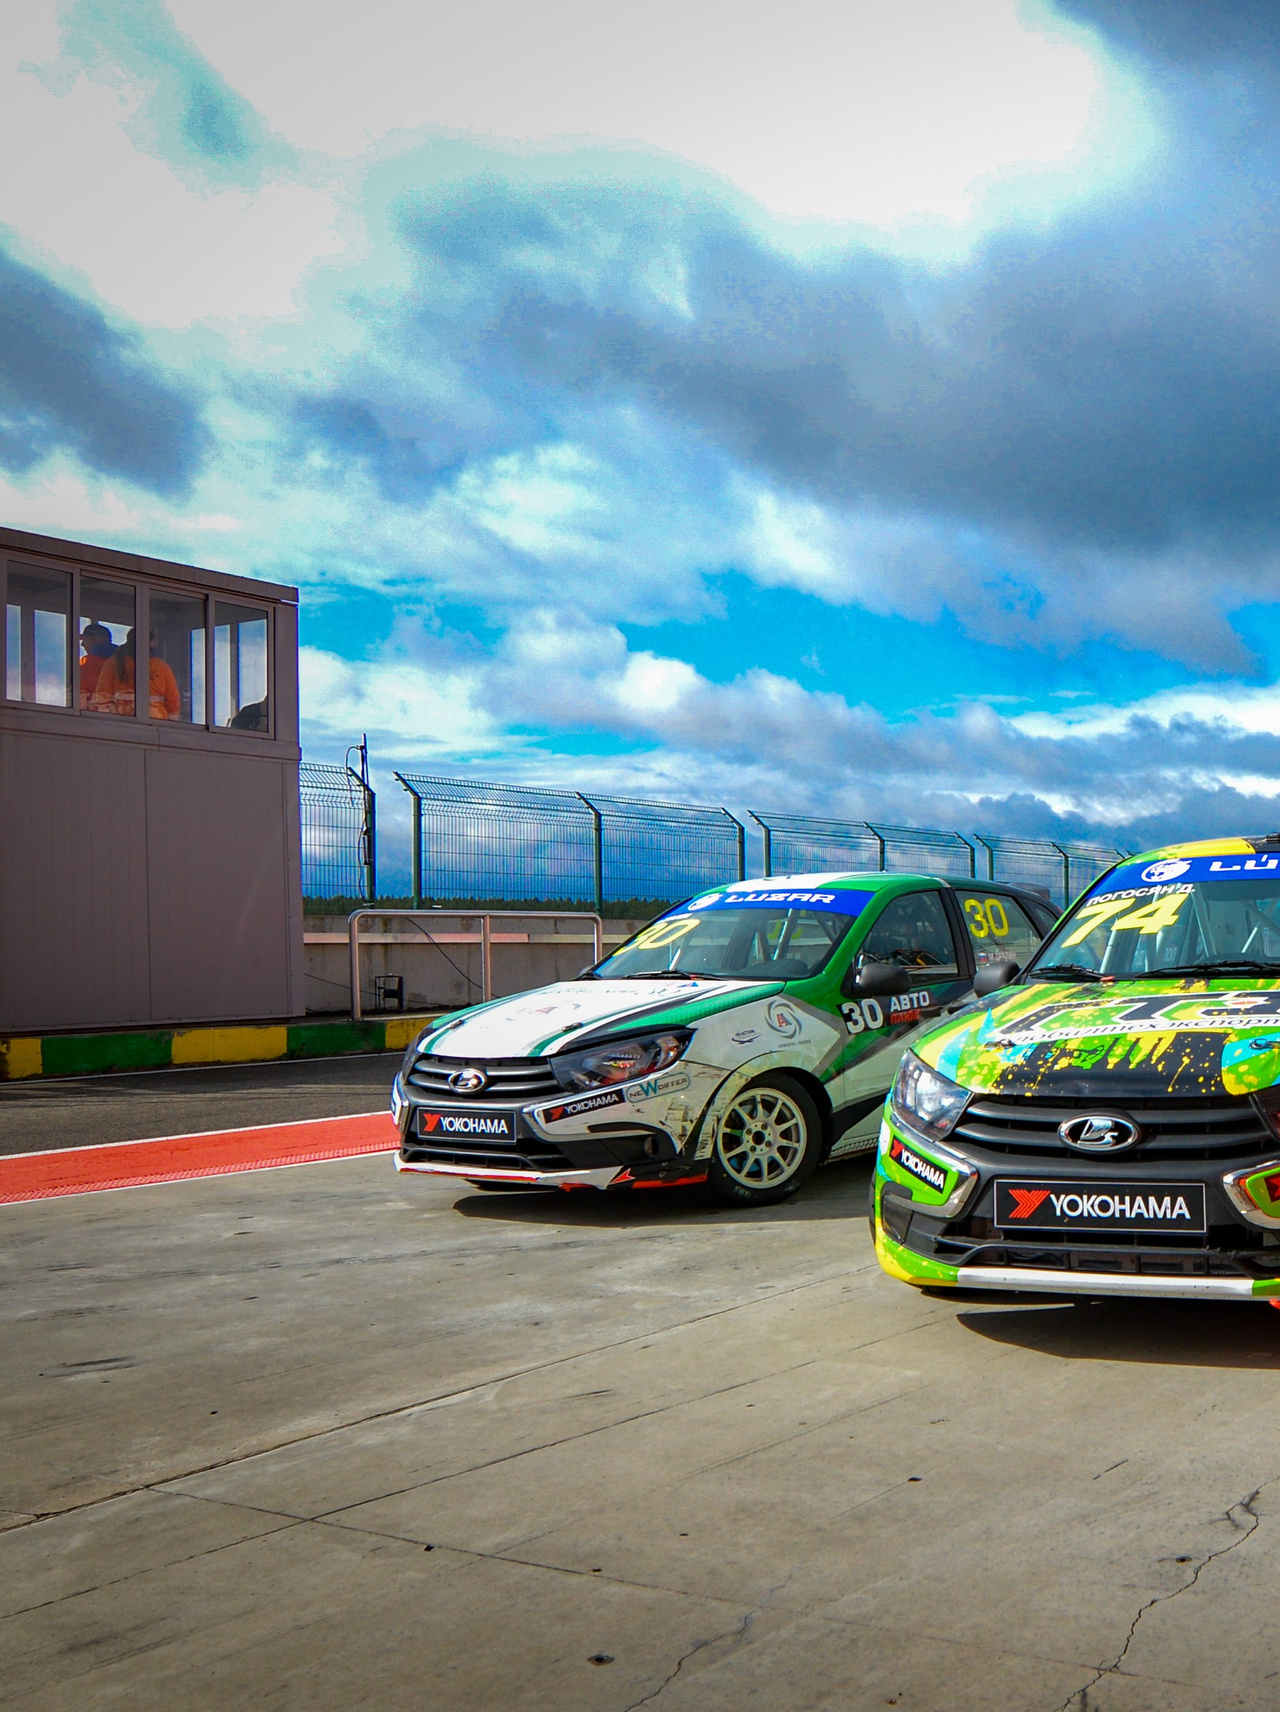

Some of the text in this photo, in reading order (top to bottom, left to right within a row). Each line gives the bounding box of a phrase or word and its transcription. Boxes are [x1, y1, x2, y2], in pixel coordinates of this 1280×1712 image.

[964, 898, 1010, 938] 30
[1061, 893, 1190, 948] 74
[841, 997, 884, 1035] 30
[890, 991, 930, 1012] АВТО
[564, 1093, 620, 1115] YOKOHAMA
[439, 1116, 509, 1135] YOKOHAMA
[900, 1148, 945, 1190] YOKOHAMA
[1050, 1193, 1191, 1220] YOKOHAMA
